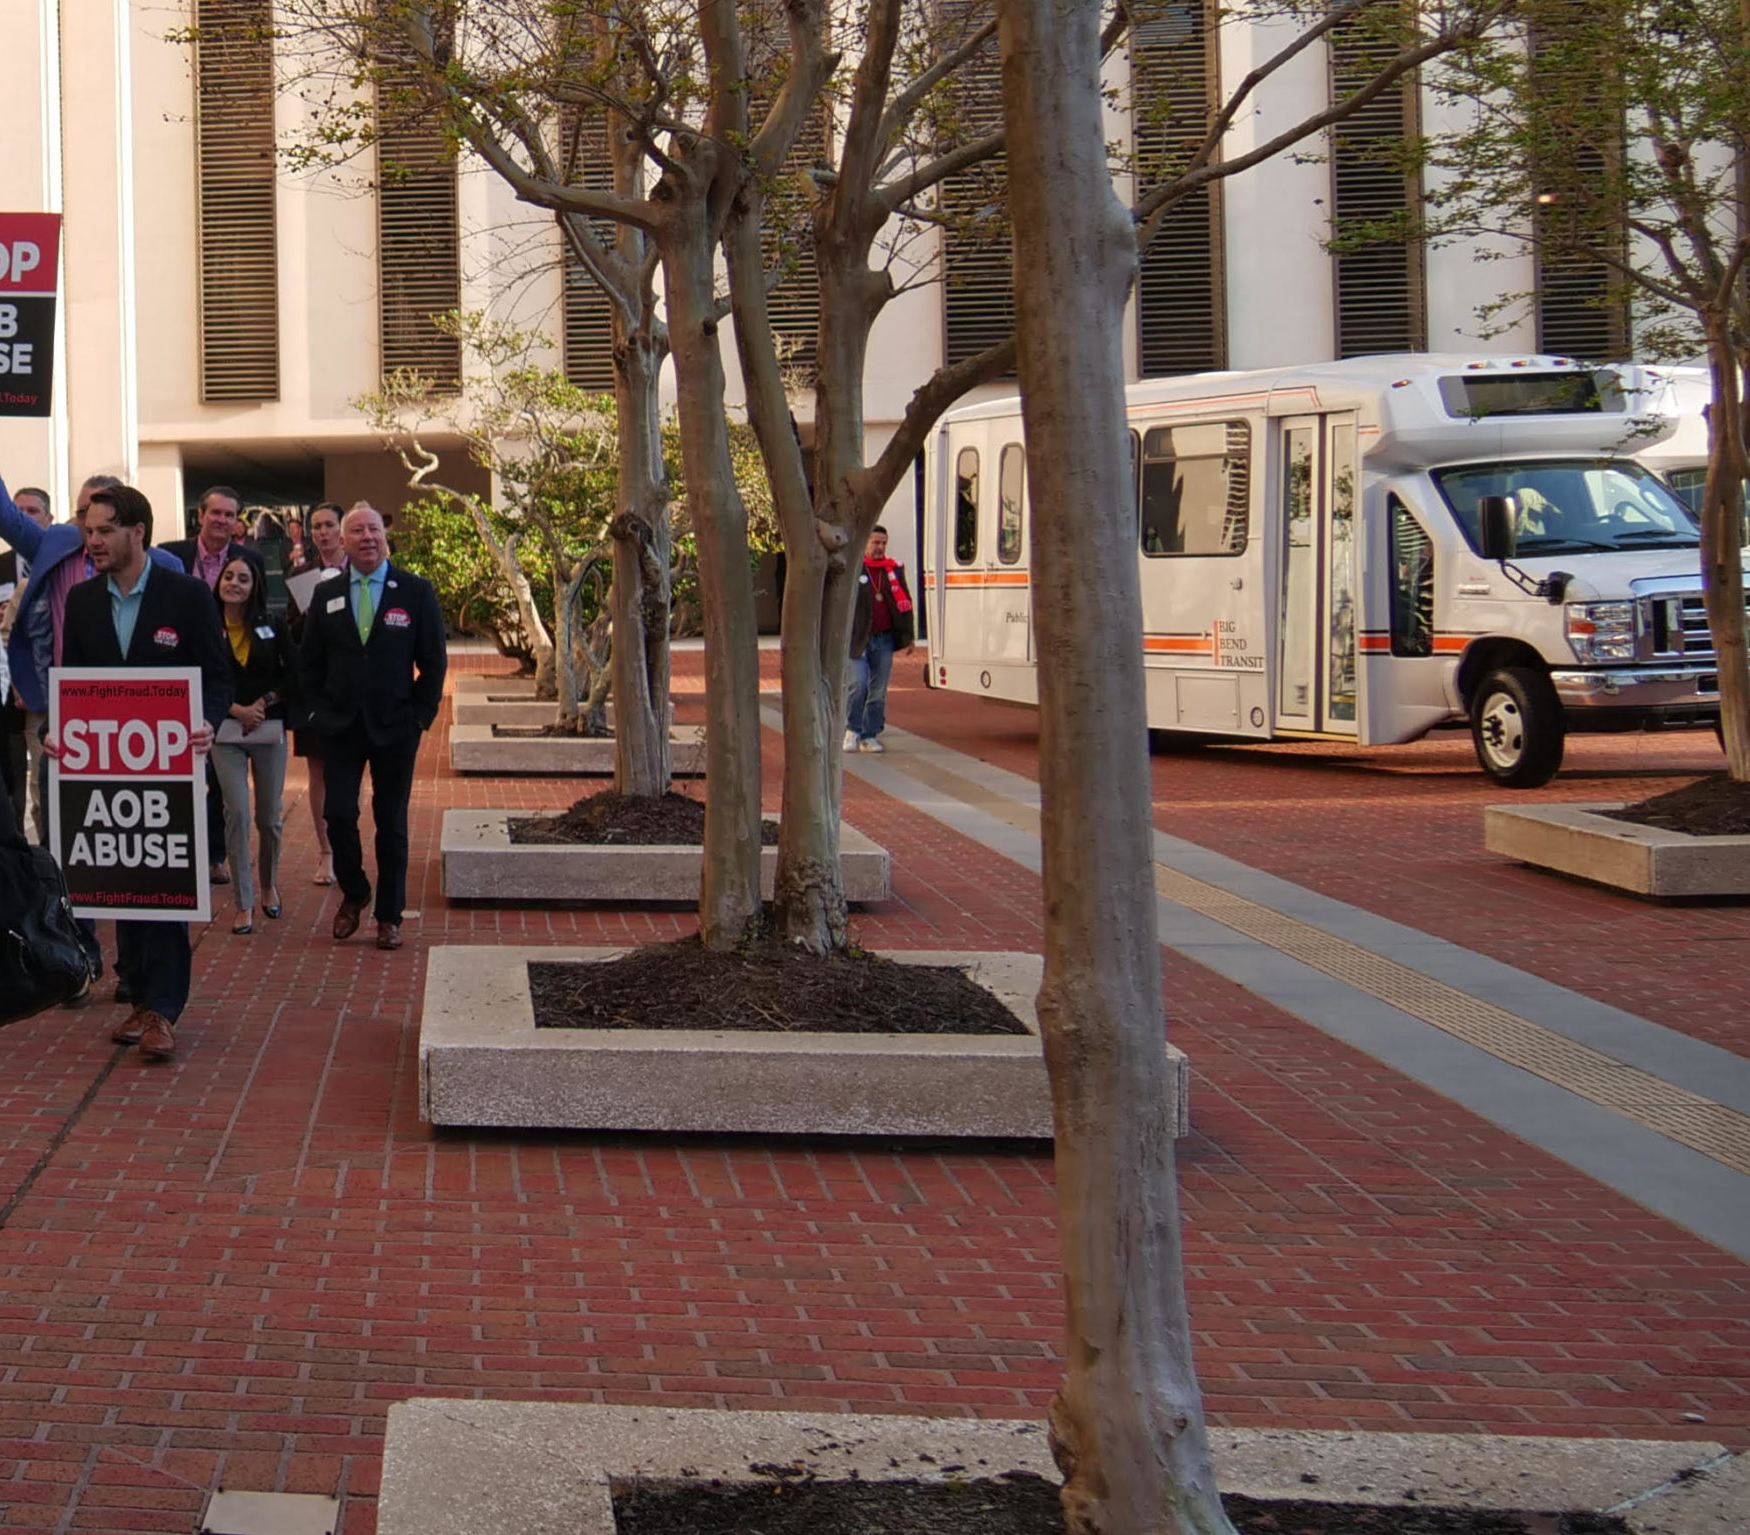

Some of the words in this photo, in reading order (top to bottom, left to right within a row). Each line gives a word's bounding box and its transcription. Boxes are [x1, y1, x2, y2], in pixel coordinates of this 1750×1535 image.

[1219, 621, 1235, 632] BIG
[1220, 639, 1247, 650] BEND
[1220, 655, 1264, 668] TRANSIT
[62, 685, 187, 698] www.FightFraud.Today
[62, 718, 188, 771] STOP
[83, 789, 170, 828] AOB
[68, 833, 189, 868] ABUSE
